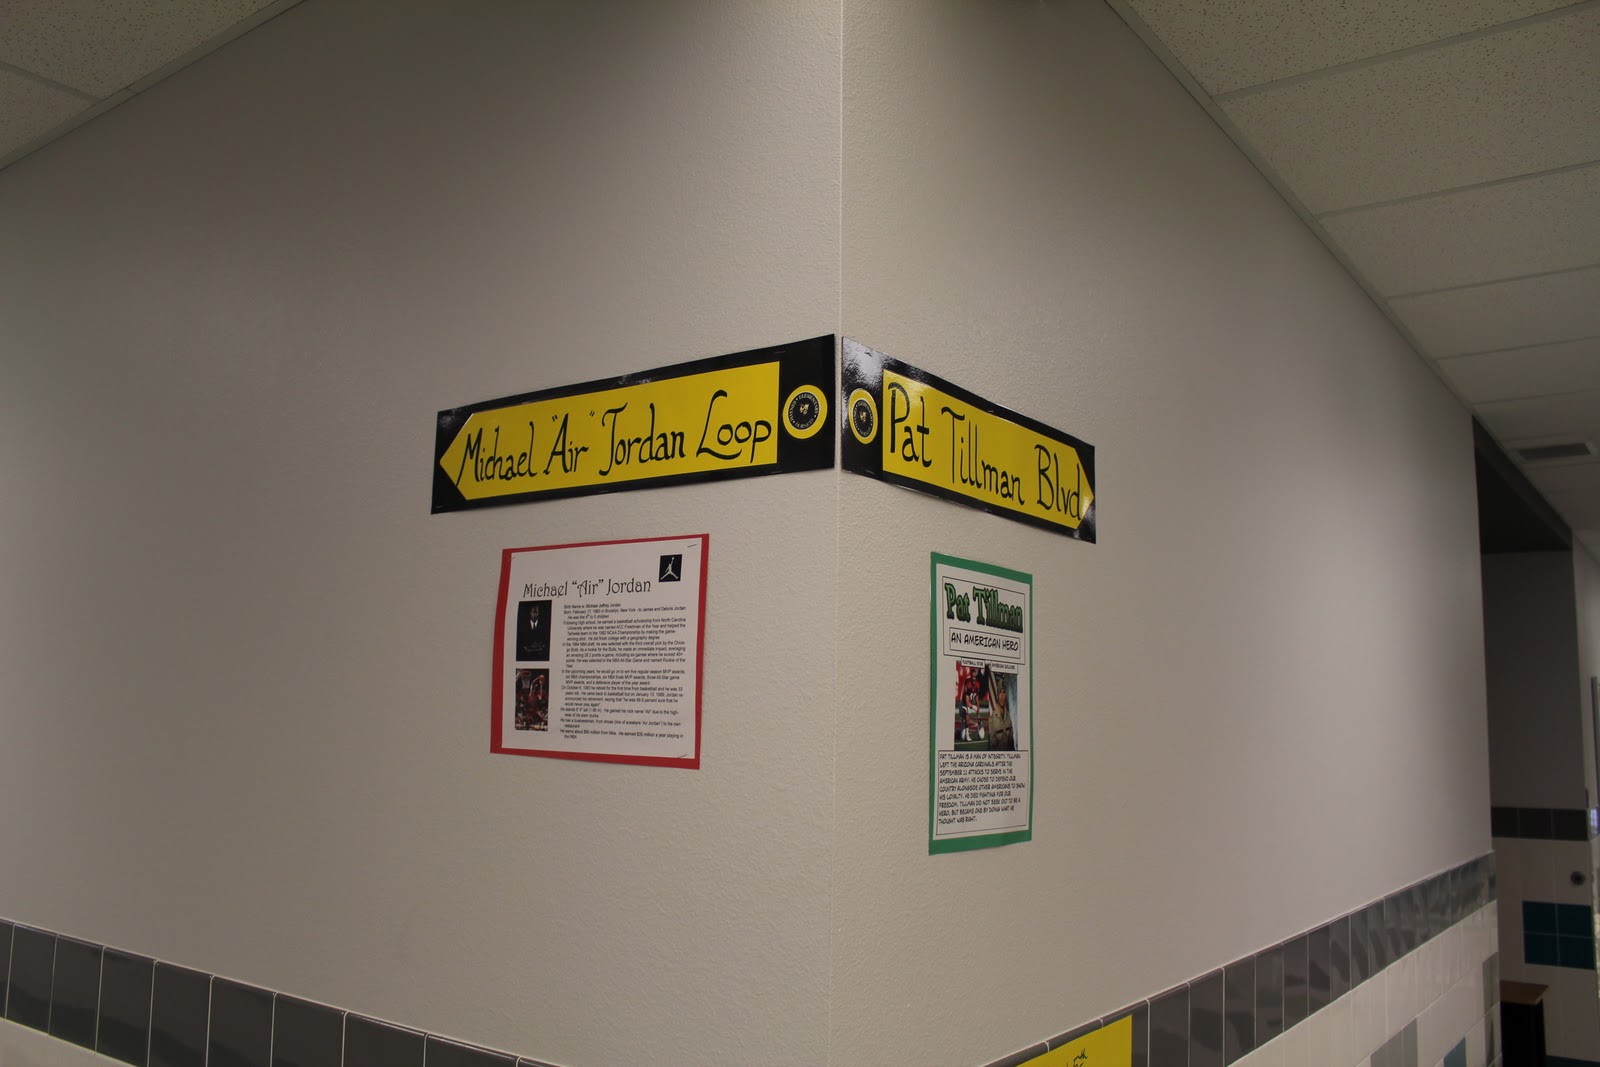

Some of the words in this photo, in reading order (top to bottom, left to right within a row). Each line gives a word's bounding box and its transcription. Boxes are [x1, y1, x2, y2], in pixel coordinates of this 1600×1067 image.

[455, 422, 536, 486] Michael
[543, 410, 596, 475] "Air"
[599, 402, 686, 476] Jordan
[696, 390, 772, 463] Loop
[888, 382, 932, 468] Pat
[941, 406, 1025, 506] Tillman
[1034, 444, 1082, 521] Blvd
[522, 580, 568, 598] Michael
[606, 578, 651, 596] Jordan
[944, 582, 971, 623] Pat
[973, 586, 1024, 634] Tillman
[951, 632, 961, 644] AN
[964, 634, 1000, 649] AMERICAN
[1002, 640, 1018, 651] HERO
